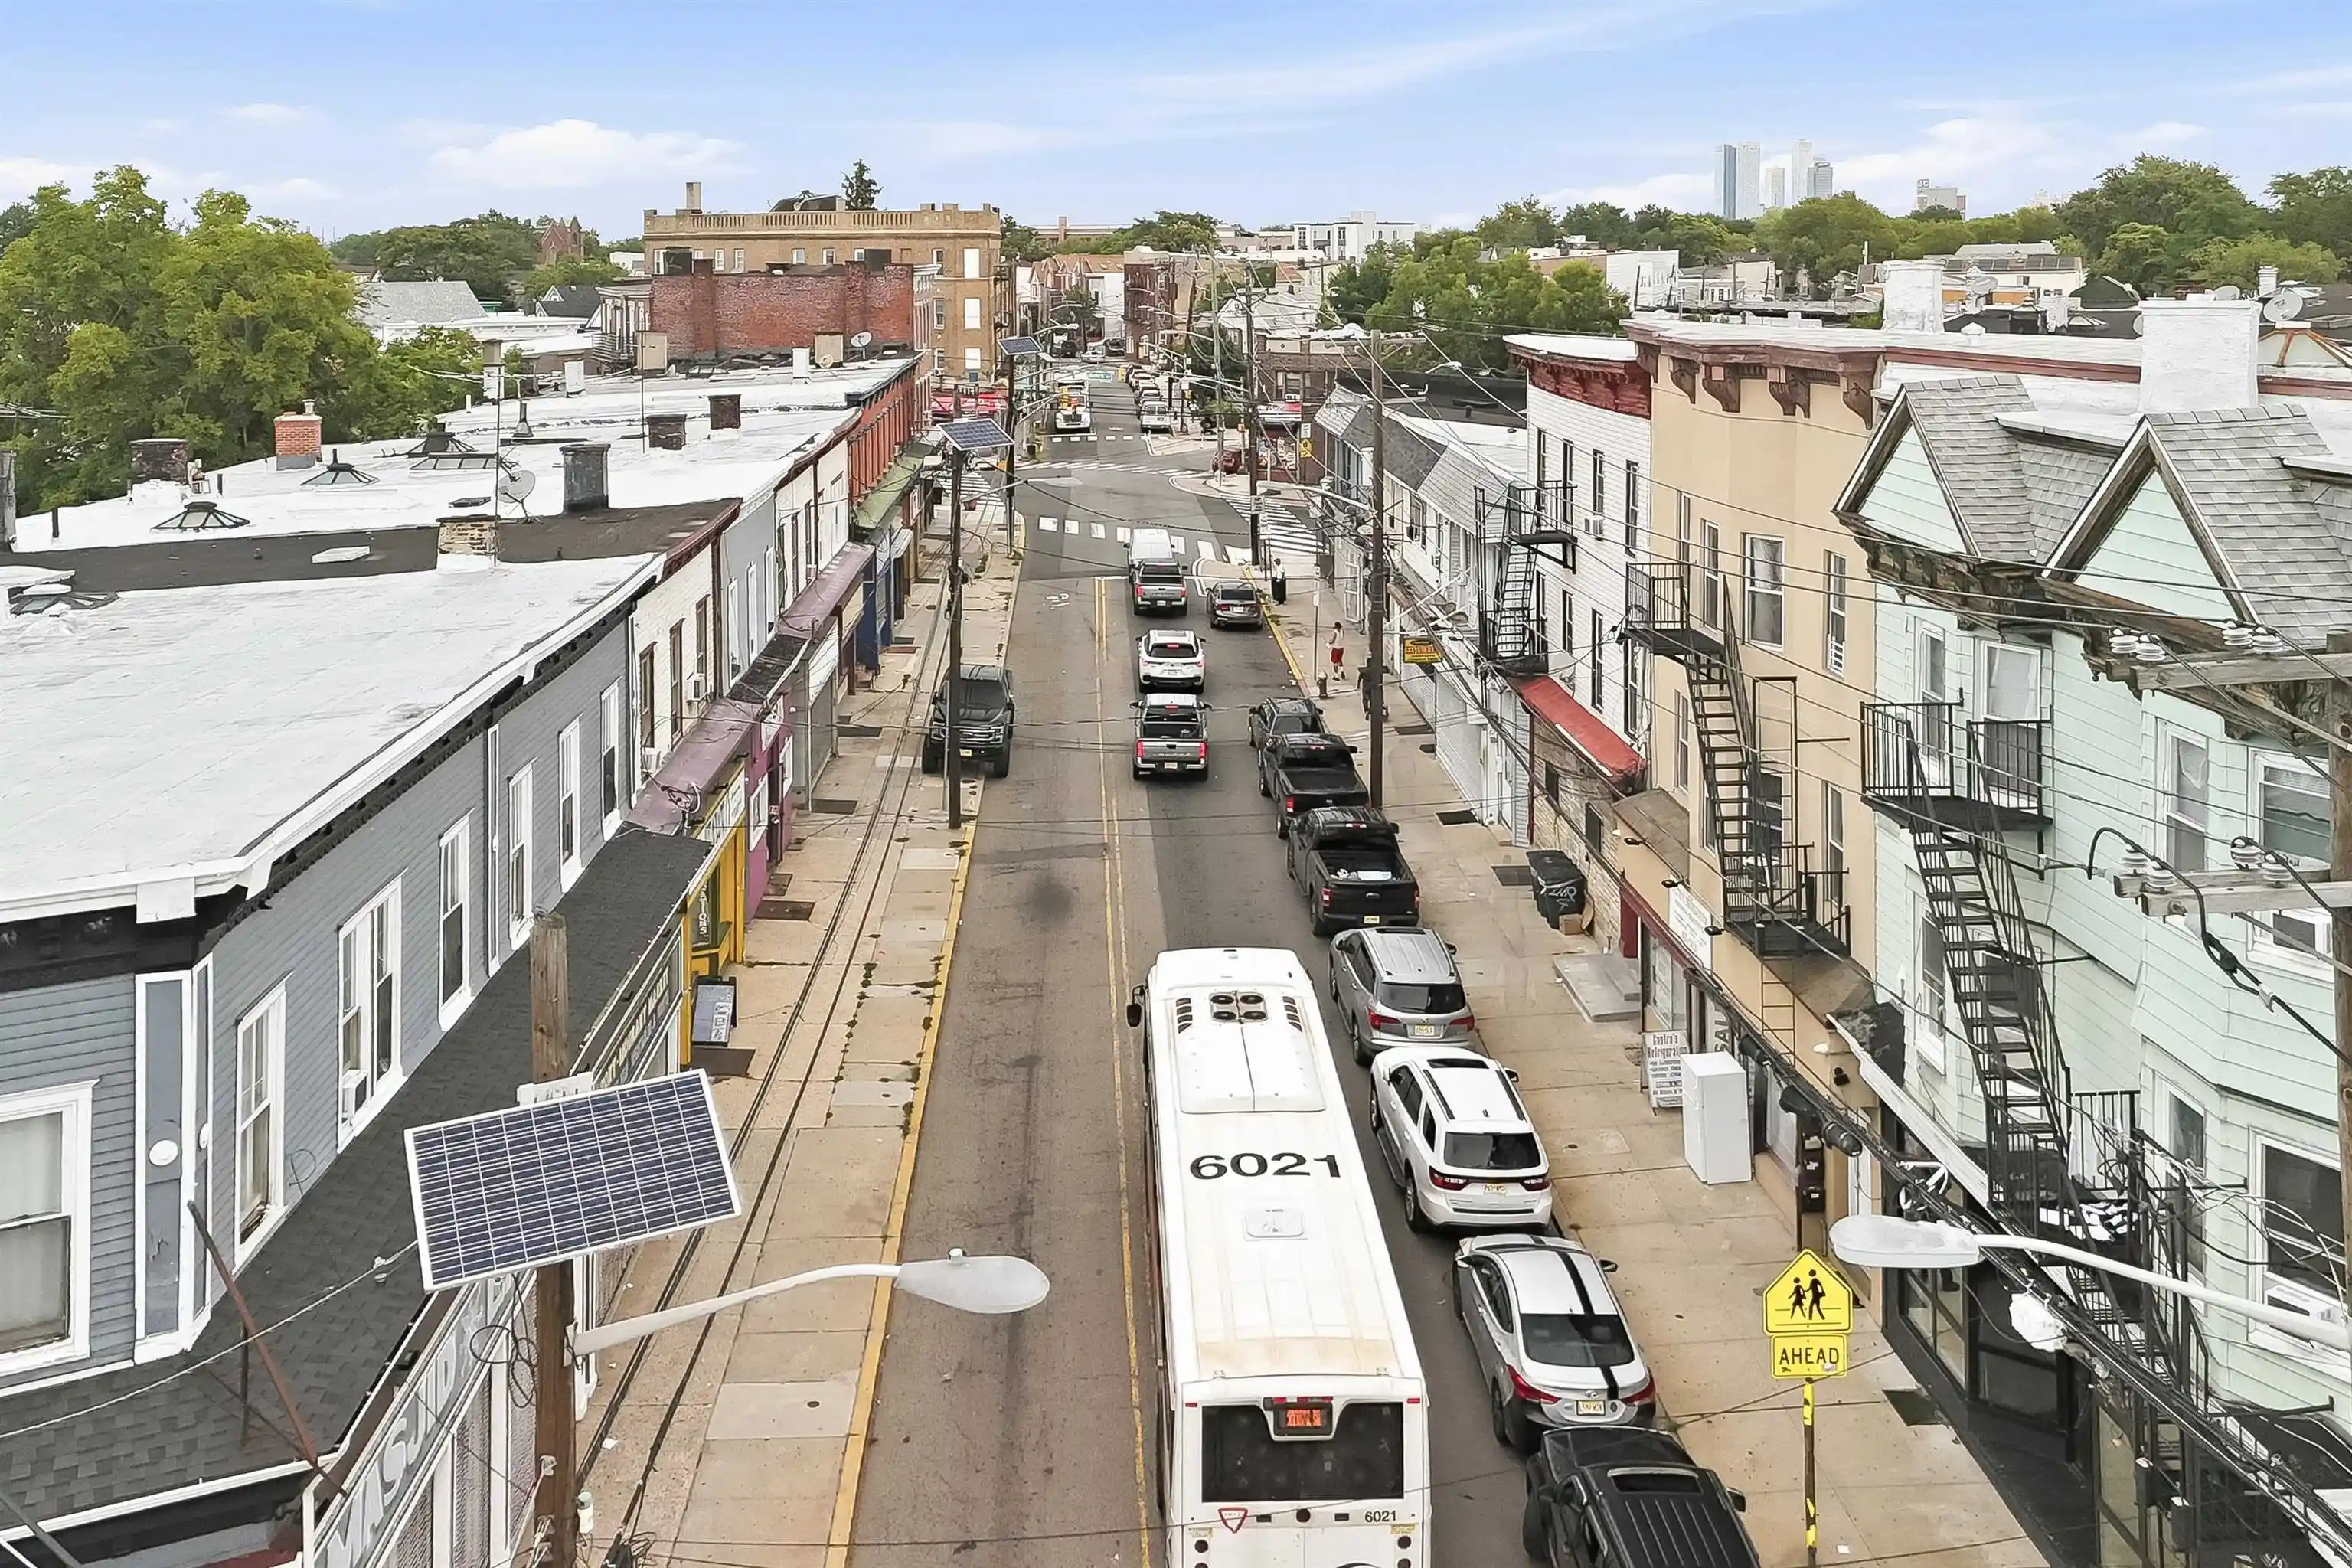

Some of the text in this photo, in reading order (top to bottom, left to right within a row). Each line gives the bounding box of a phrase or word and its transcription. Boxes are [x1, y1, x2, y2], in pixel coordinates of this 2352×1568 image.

[1190, 1152, 1341, 1180] 6021
[1779, 1347, 1840, 1365] AHEAD
[326, 1334, 456, 1568] MASJID
[1364, 1510, 1396, 1523] 6021
